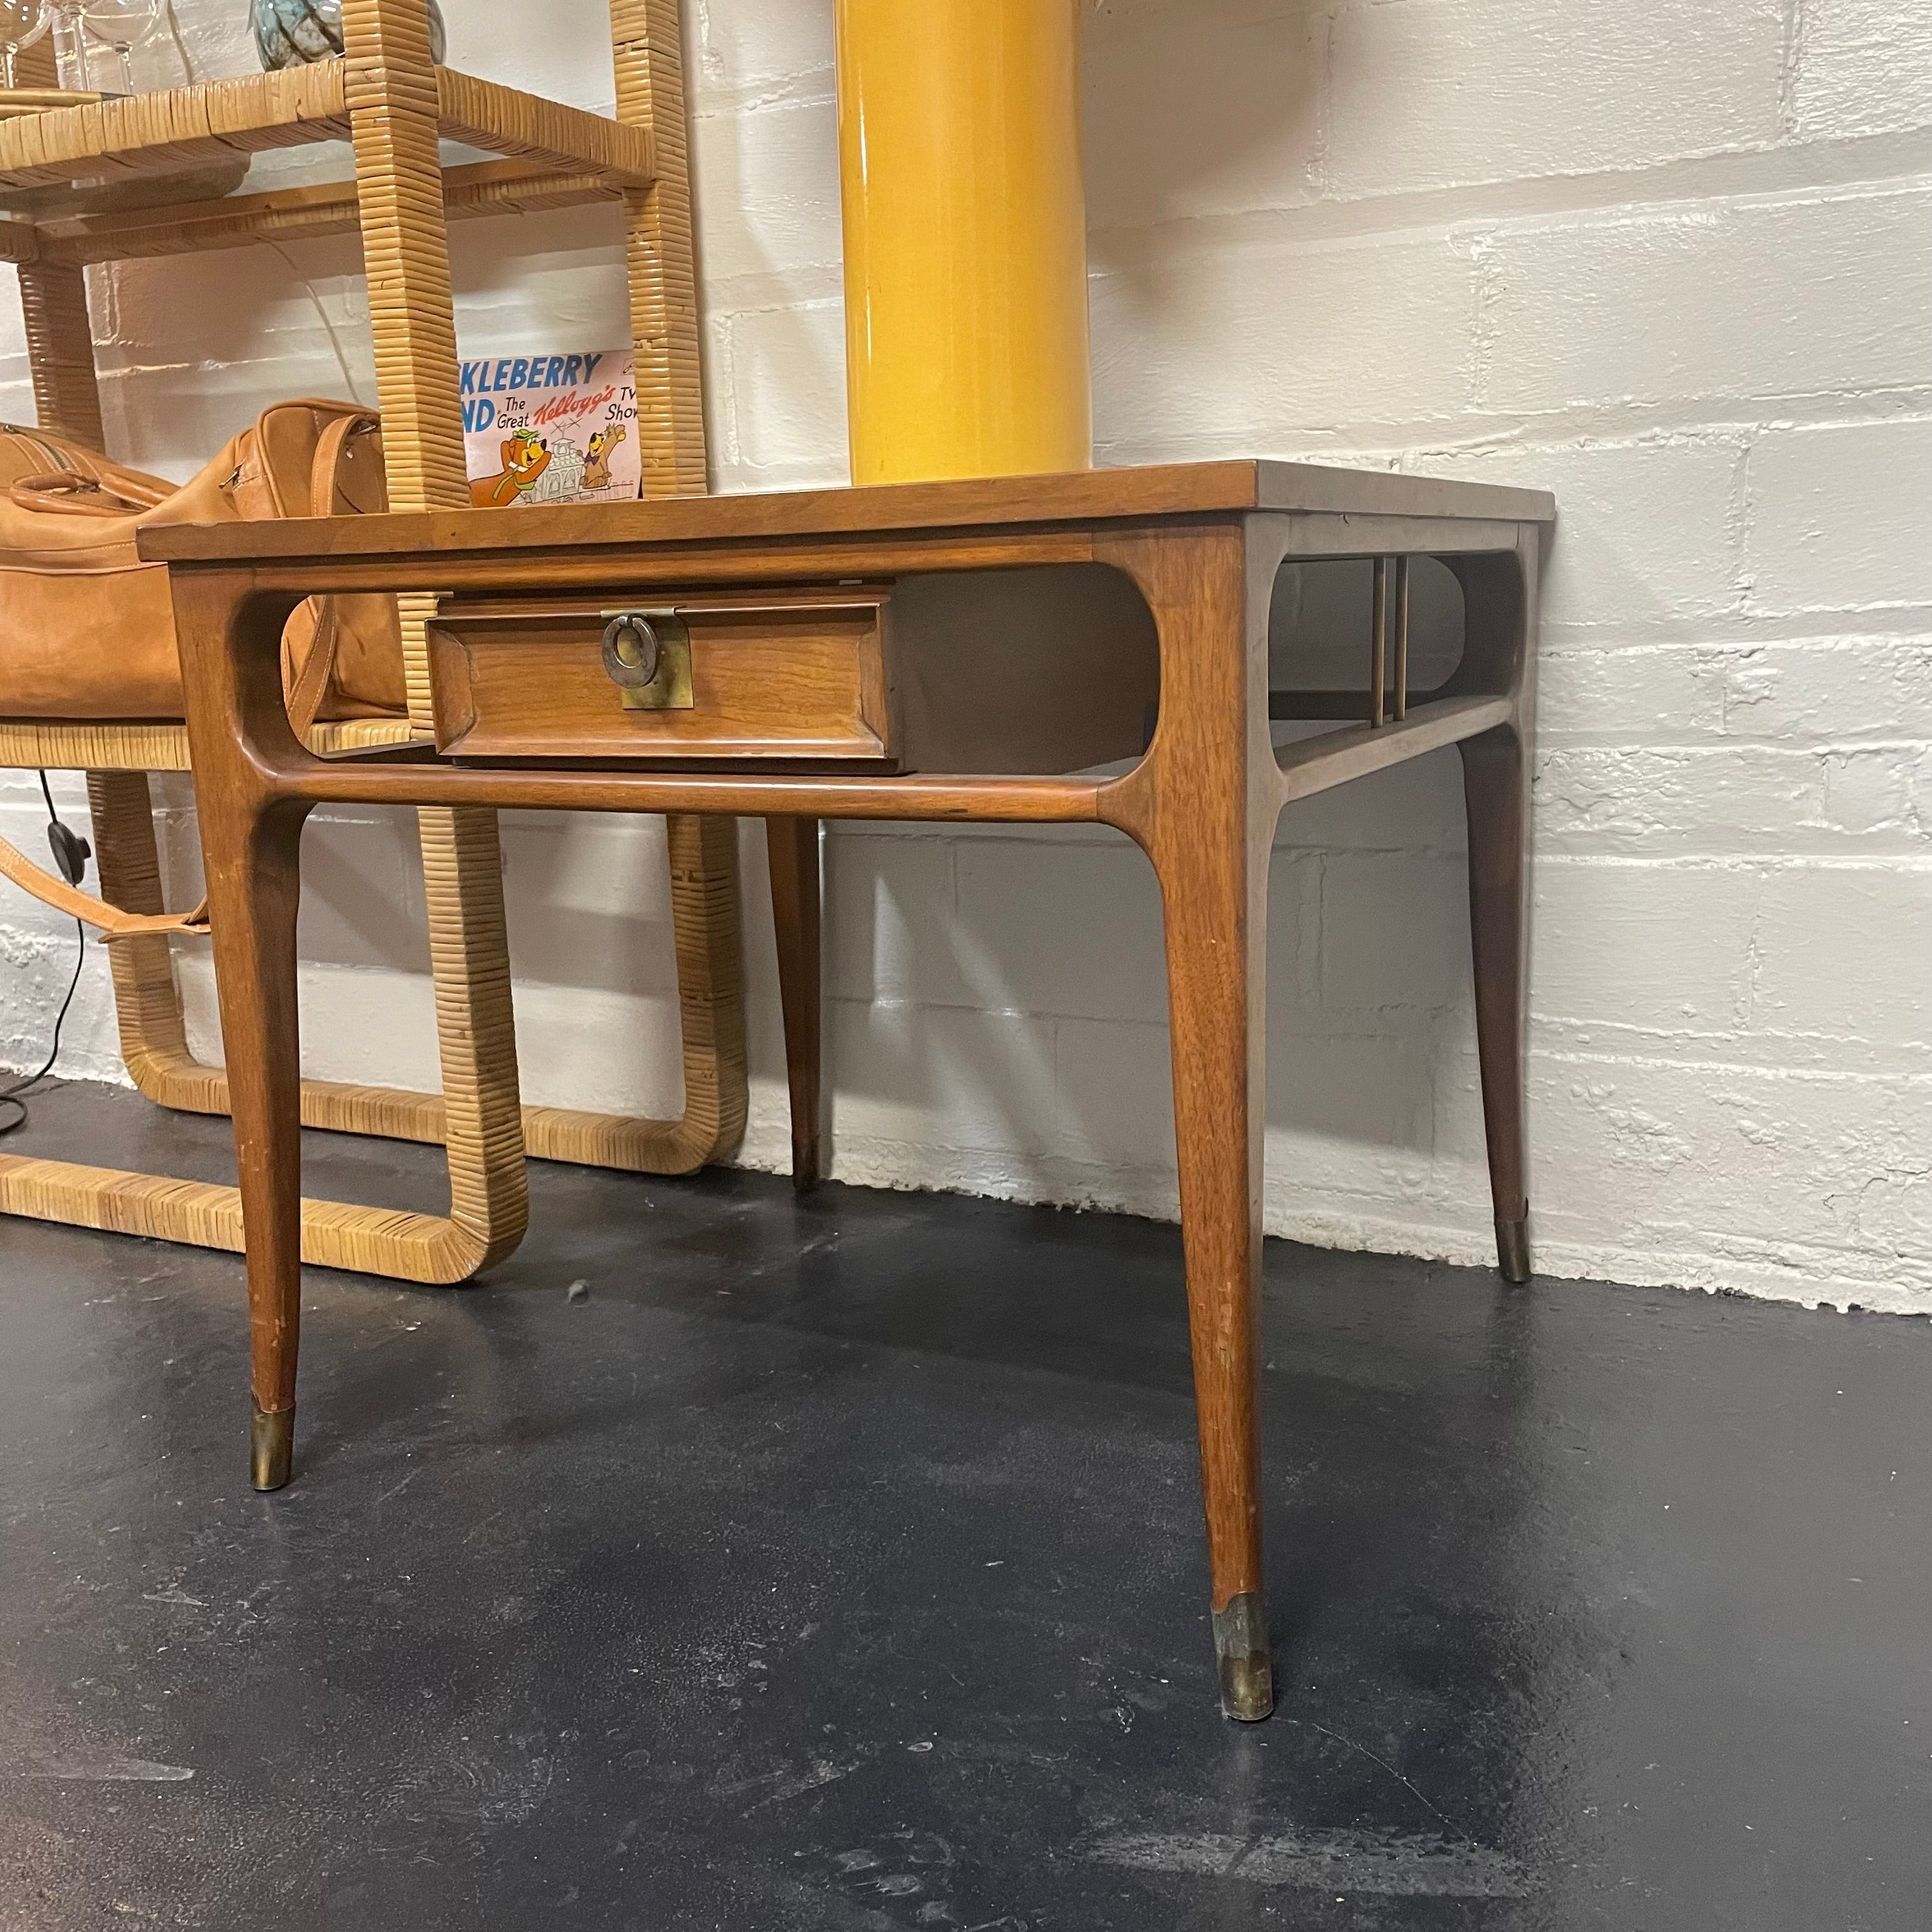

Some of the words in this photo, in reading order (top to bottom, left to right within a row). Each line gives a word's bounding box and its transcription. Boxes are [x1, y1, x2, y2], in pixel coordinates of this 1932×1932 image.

[457, 353, 602, 395] KLEBERRY
[497, 412, 532, 429] Great
[533, 385, 616, 425] Kellogg's
[505, 396, 526, 411] The
